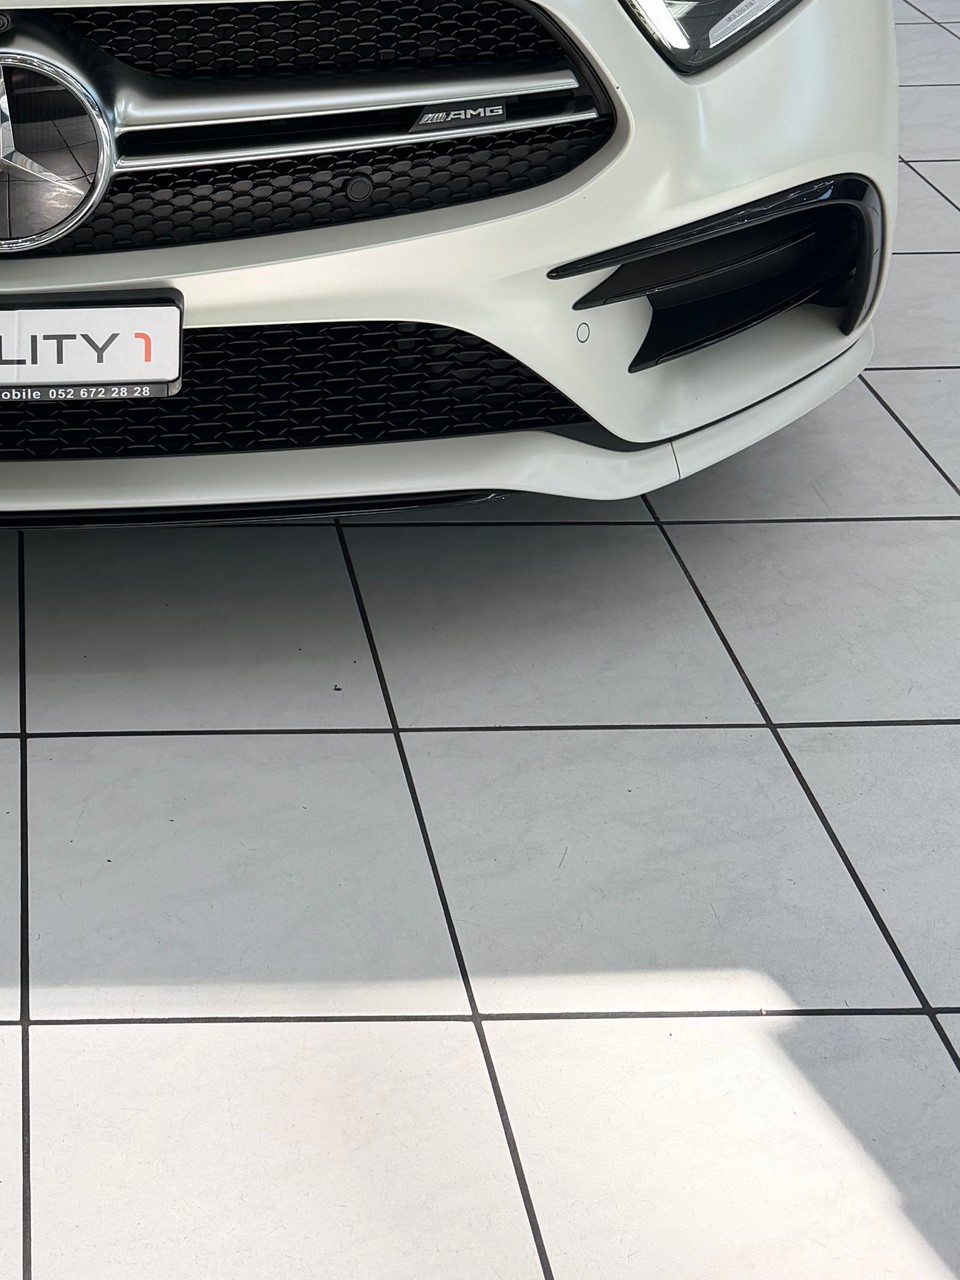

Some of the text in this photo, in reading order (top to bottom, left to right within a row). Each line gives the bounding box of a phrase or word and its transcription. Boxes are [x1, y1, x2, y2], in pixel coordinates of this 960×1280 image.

[134, 332, 152, 363] 1
[48, 388, 75, 400] 052
[80, 387, 106, 399] 672
[111, 387, 128, 398] 28
[133, 386, 151, 397] 28
